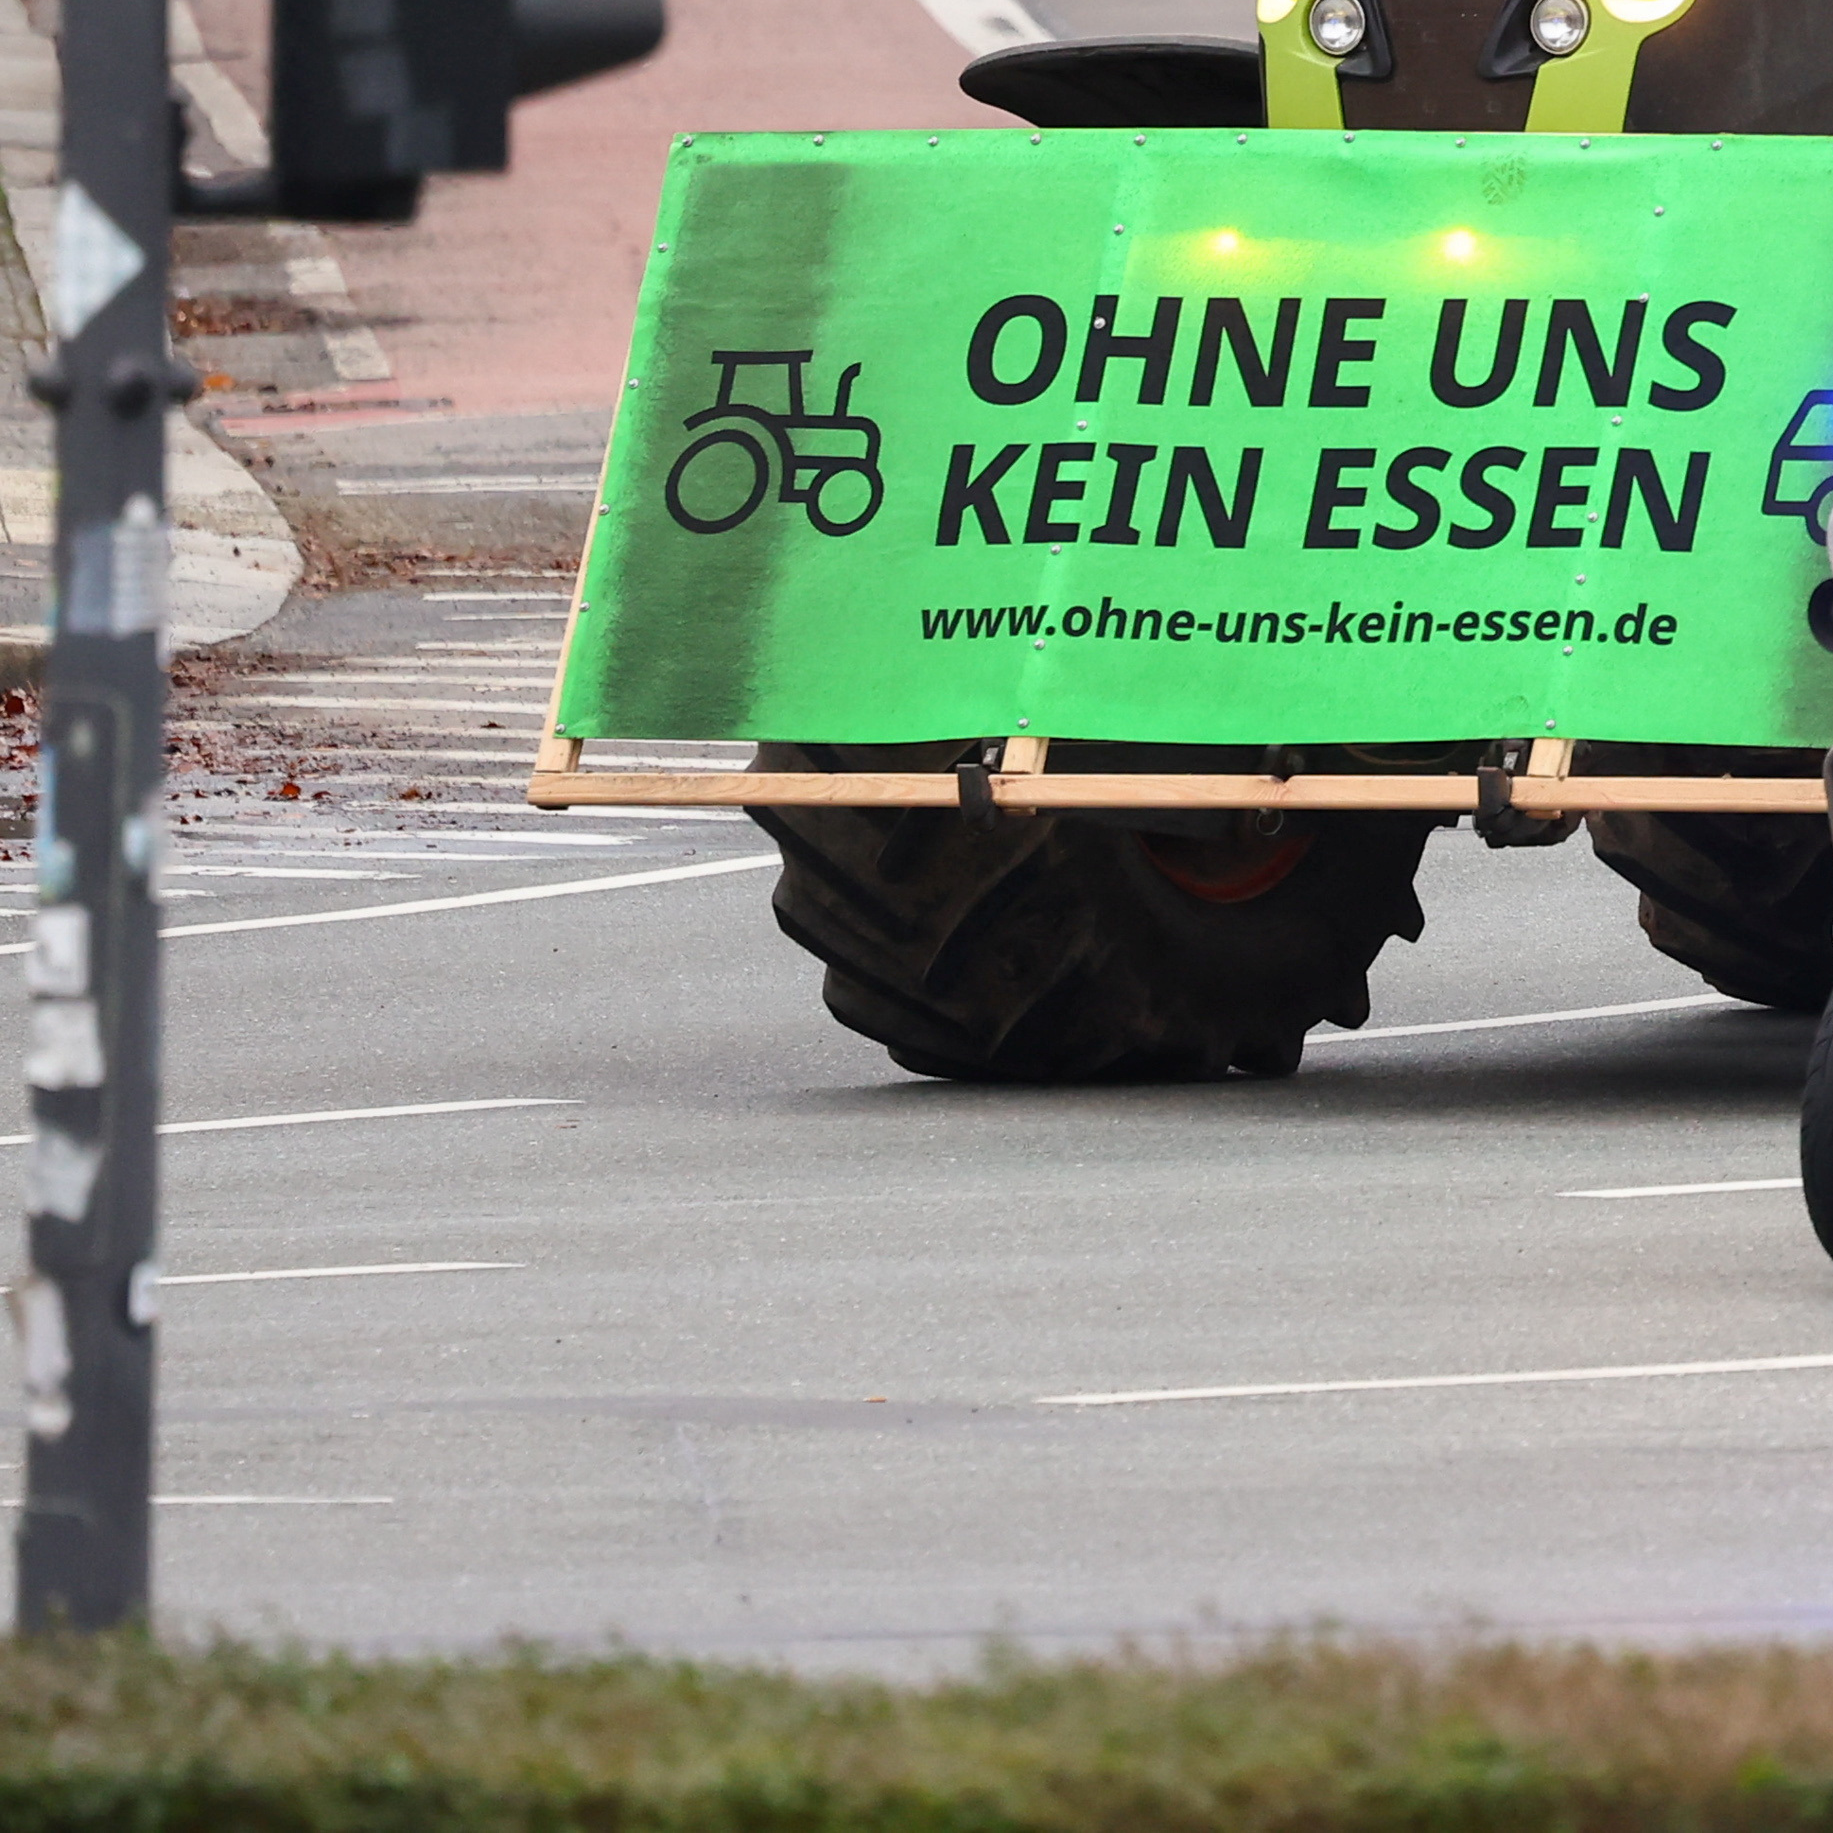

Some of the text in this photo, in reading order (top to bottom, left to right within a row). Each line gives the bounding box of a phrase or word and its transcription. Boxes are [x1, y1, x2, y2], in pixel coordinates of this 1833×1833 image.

[965, 294, 1738, 412] OHNE UNS
[934, 441, 1711, 553] KEIN ESSEN
[920, 597, 1679, 647] www.ohne-uns-kein-essen.de
